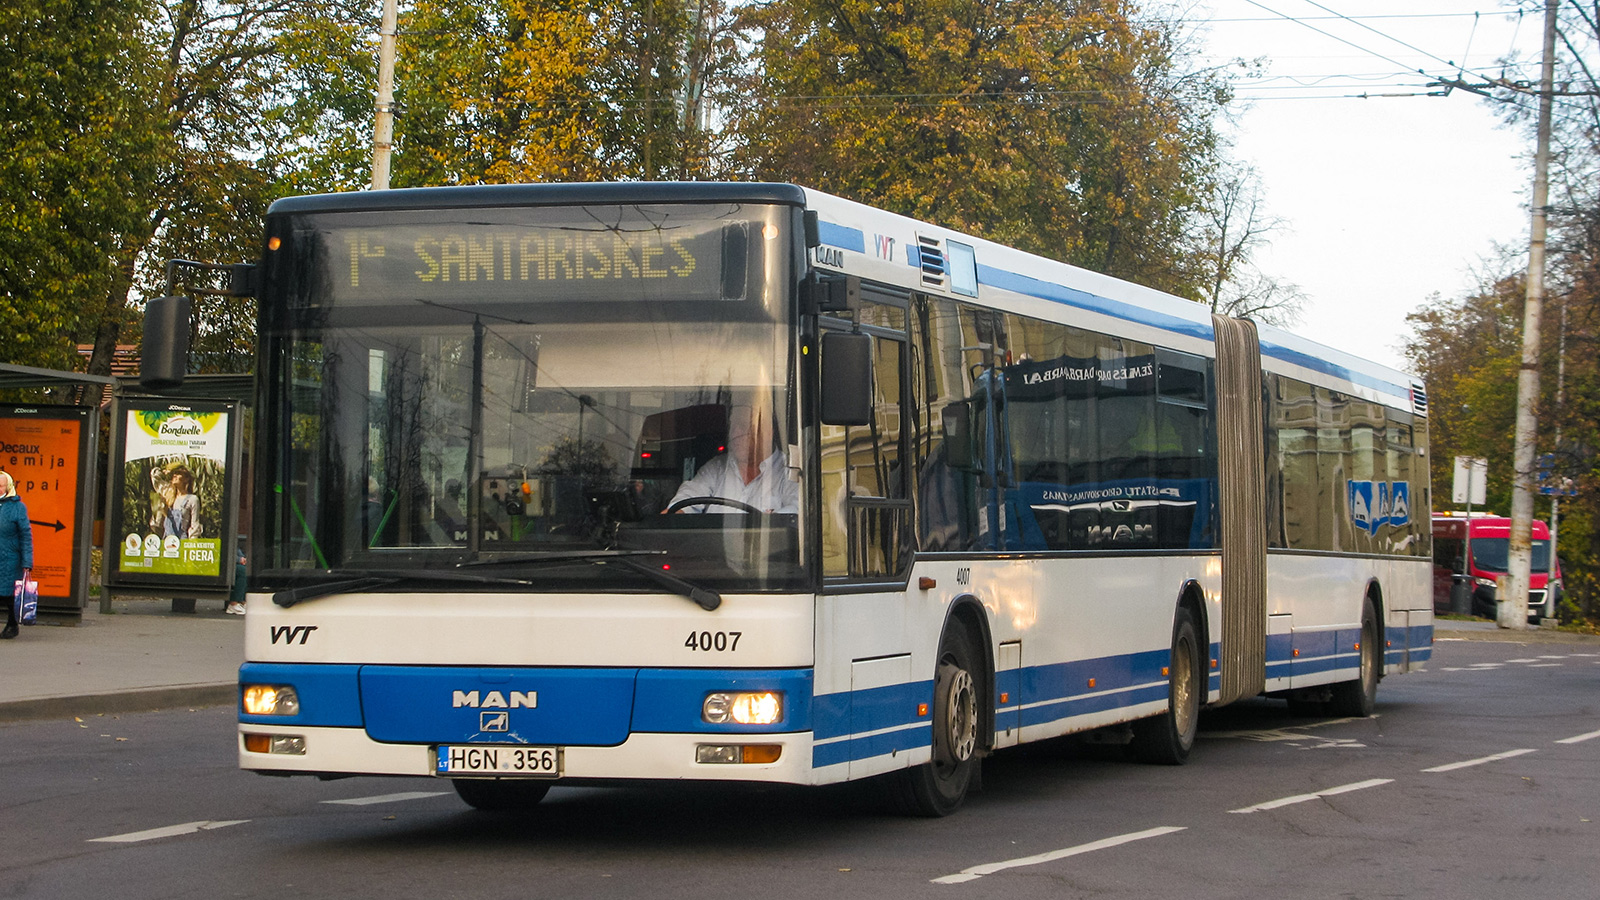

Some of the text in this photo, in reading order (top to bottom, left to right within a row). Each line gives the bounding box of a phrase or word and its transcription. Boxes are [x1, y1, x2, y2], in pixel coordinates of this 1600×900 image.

[414, 231, 696, 282] SANTARISKES
[815, 246, 844, 268] MAN
[873, 233, 896, 261] VVT
[161, 424, 201, 437] Bonduelle
[189, 550, 214, 563] GERĄ
[956, 568, 970, 585] 4007
[271, 625, 318, 645] VVT
[685, 631, 743, 652] 4007
[452, 690, 537, 709] MAN
[451, 749, 498, 769] HGN
[514, 750, 553, 770] 356
